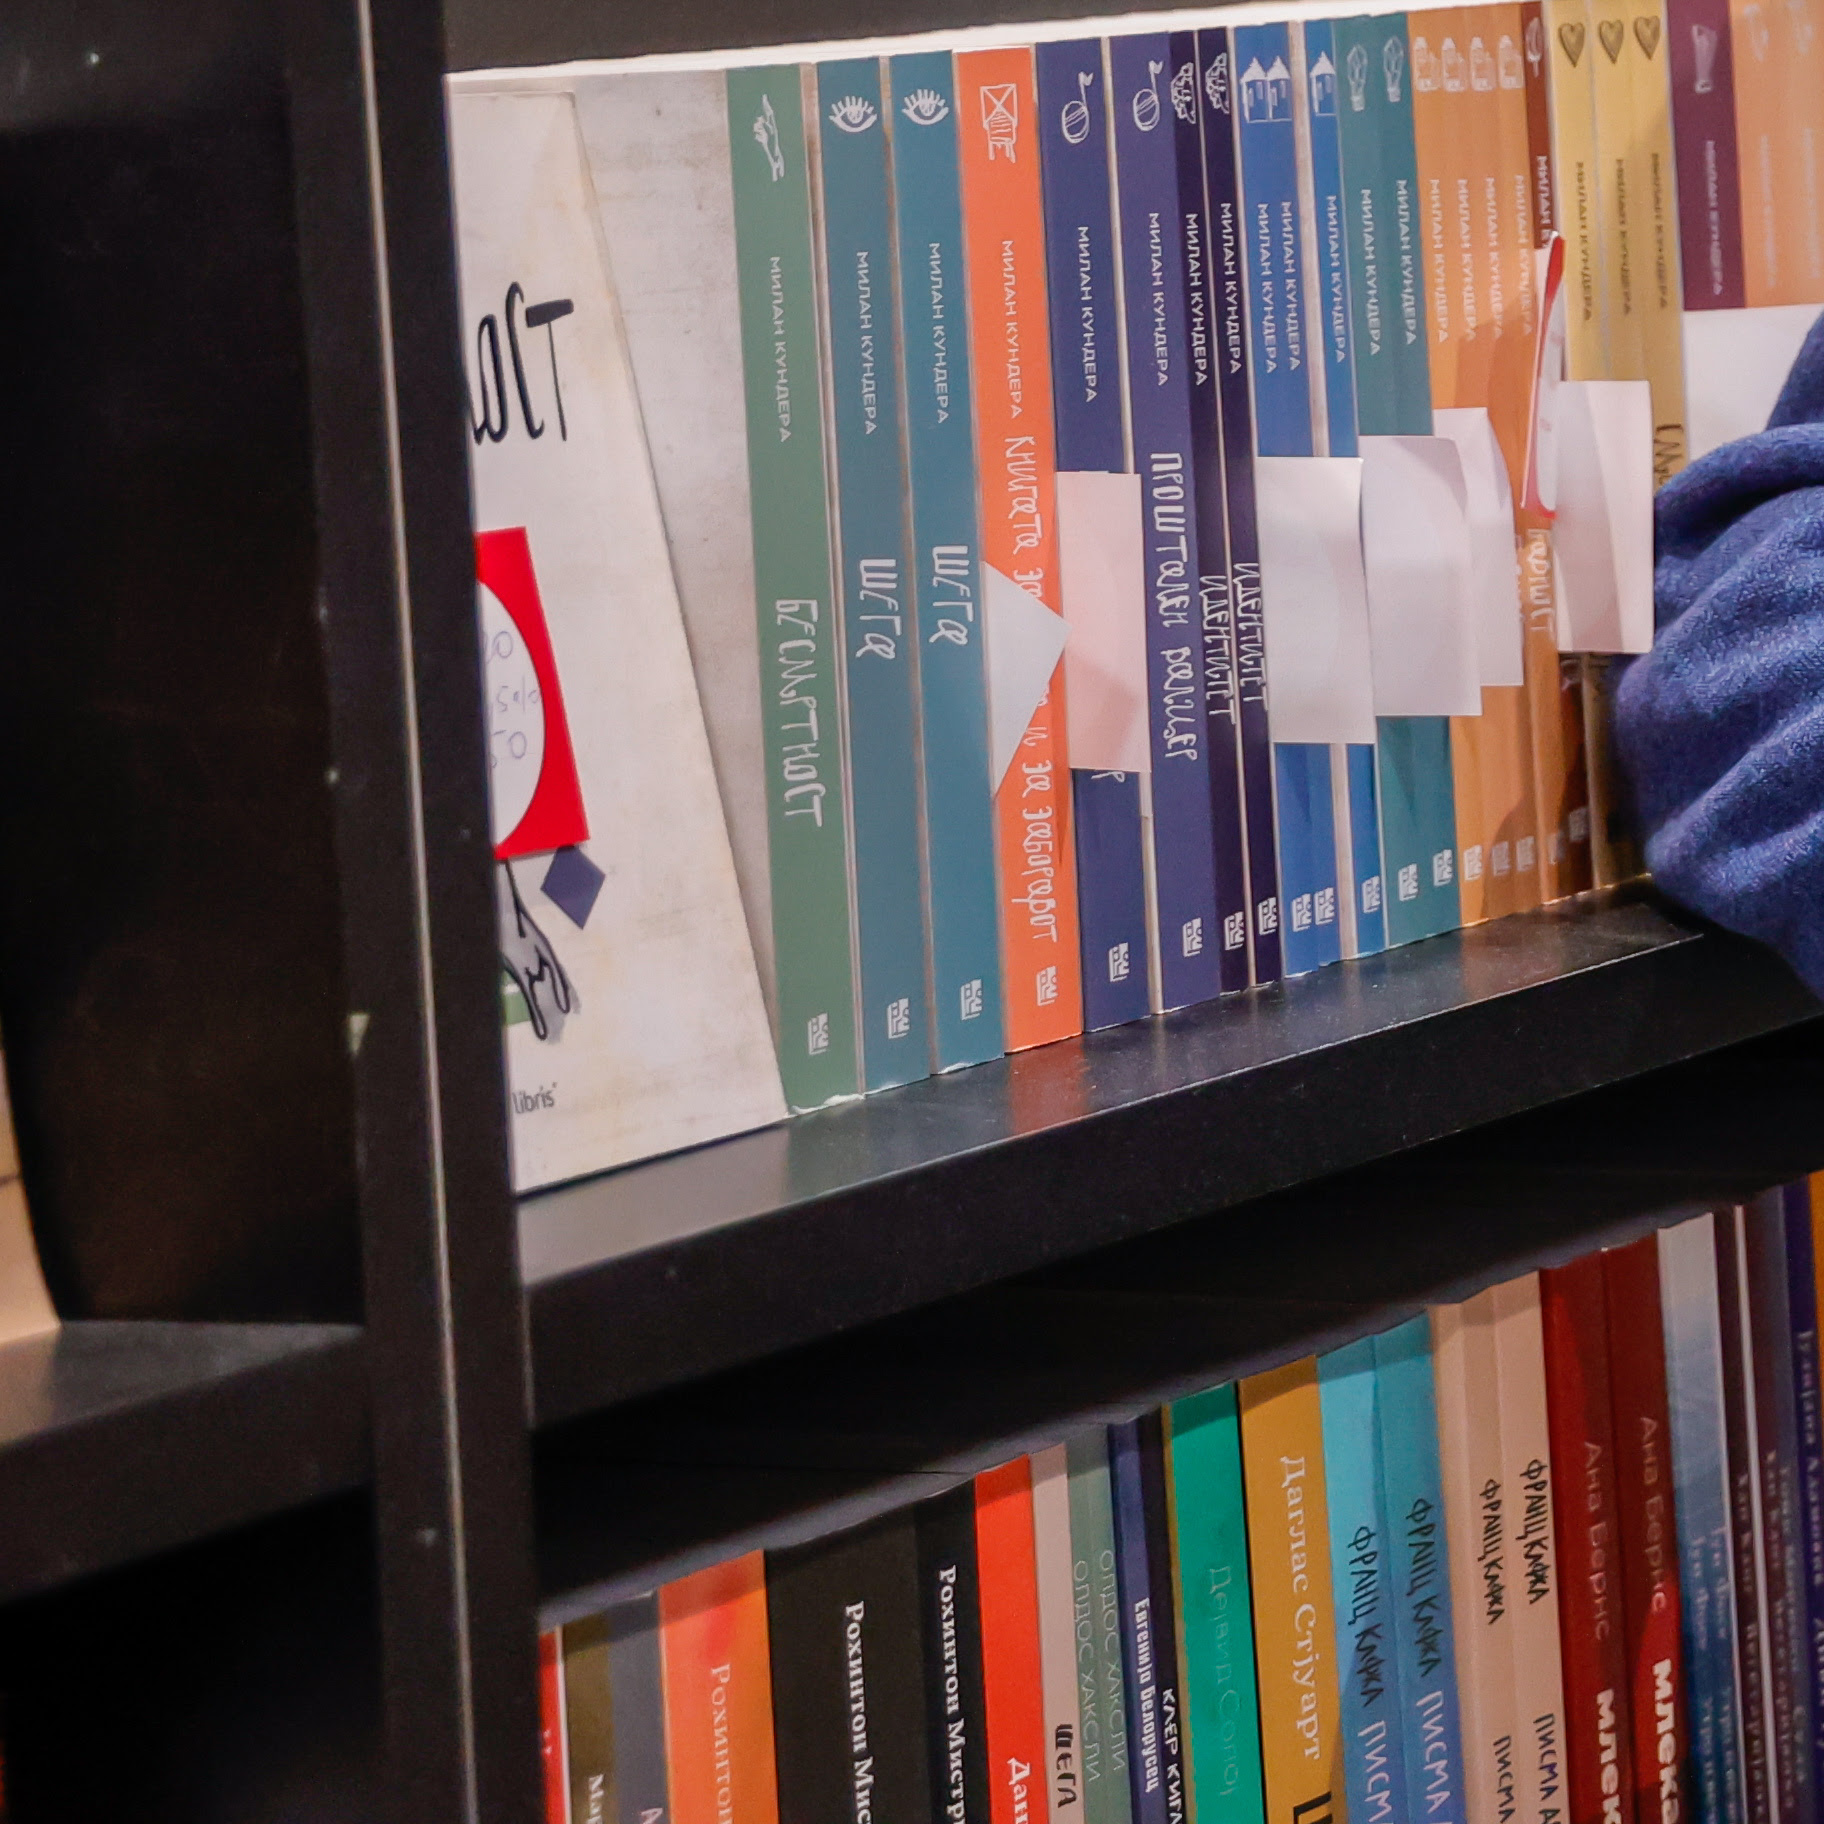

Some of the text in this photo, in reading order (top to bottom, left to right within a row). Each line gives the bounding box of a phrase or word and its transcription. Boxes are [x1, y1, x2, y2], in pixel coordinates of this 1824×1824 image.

[929, 242, 949, 424] МИЛАН КУНДЕРА
[1002, 240, 1022, 419] МИЛАН КУНДЕРА
[1078, 226, 1097, 402] МИЛАН КУНДЕРА
[1149, 212, 1168, 386] МИЛАН КУНДЕРА
[1186, 213, 1208, 386] МИЛАН КУНДЕРА
[1220, 203, 1241, 374] МИЛАН КУНДЕРА
[1258, 203, 1277, 373] МИЛАН КУНДЕРА
[1281, 201, 1300, 371] МИЛАН КУНДЕРА
[1326, 195, 1346, 363] МИЛАН КУНДЕРА
[1361, 188, 1381, 356] МИЛАН КУНДЕРА
[1396, 179, 1417, 345] МИЛАН КУНДЕРА
[1430, 179, 1449, 343] МИЛАН КУНДЕРА
[1457, 178, 1476, 341] МИЛАН КУНДЕРА
[770, 256, 791, 443] МИЛАН КУНДЕРА
[857, 251, 877, 435] МИЛАН КУНДЕРА
[1280, 1456, 1312, 1592] Даглас
[1478, 1479, 1503, 1561] ФРАНЦ
[1516, 1458, 1549, 1542] ФРАНЦ
[1643, 1495, 1668, 1614] Бернс
[939, 1565, 963, 1713] Рохинтон
[1100, 1549, 1126, 1772] ОЛДОС ХАКСЛИ
[1208, 1567, 1234, 1684] Дејвид
[1347, 1526, 1385, 1707] ФРАНЦ КАФКА
[1405, 1498, 1443, 1677] ФРАНЦ КАФКА
[845, 1602, 873, 1751] Рохинтон
[1073, 1560, 1101, 1783] ОЛДОС ХАКСЛИ
[1139, 1685, 1160, 1793] Белорусец
[1161, 1689, 1179, 1755] КЛЕР
[1291, 1602, 1322, 1761] Стјуарт
[1416, 1690, 1452, 1813] ПИСМА
[1055, 1723, 1078, 1809] ШЕГА
[1493, 1735, 1516, 1824] ПИСМА
[1533, 1712, 1560, 1801] ПИСМА
